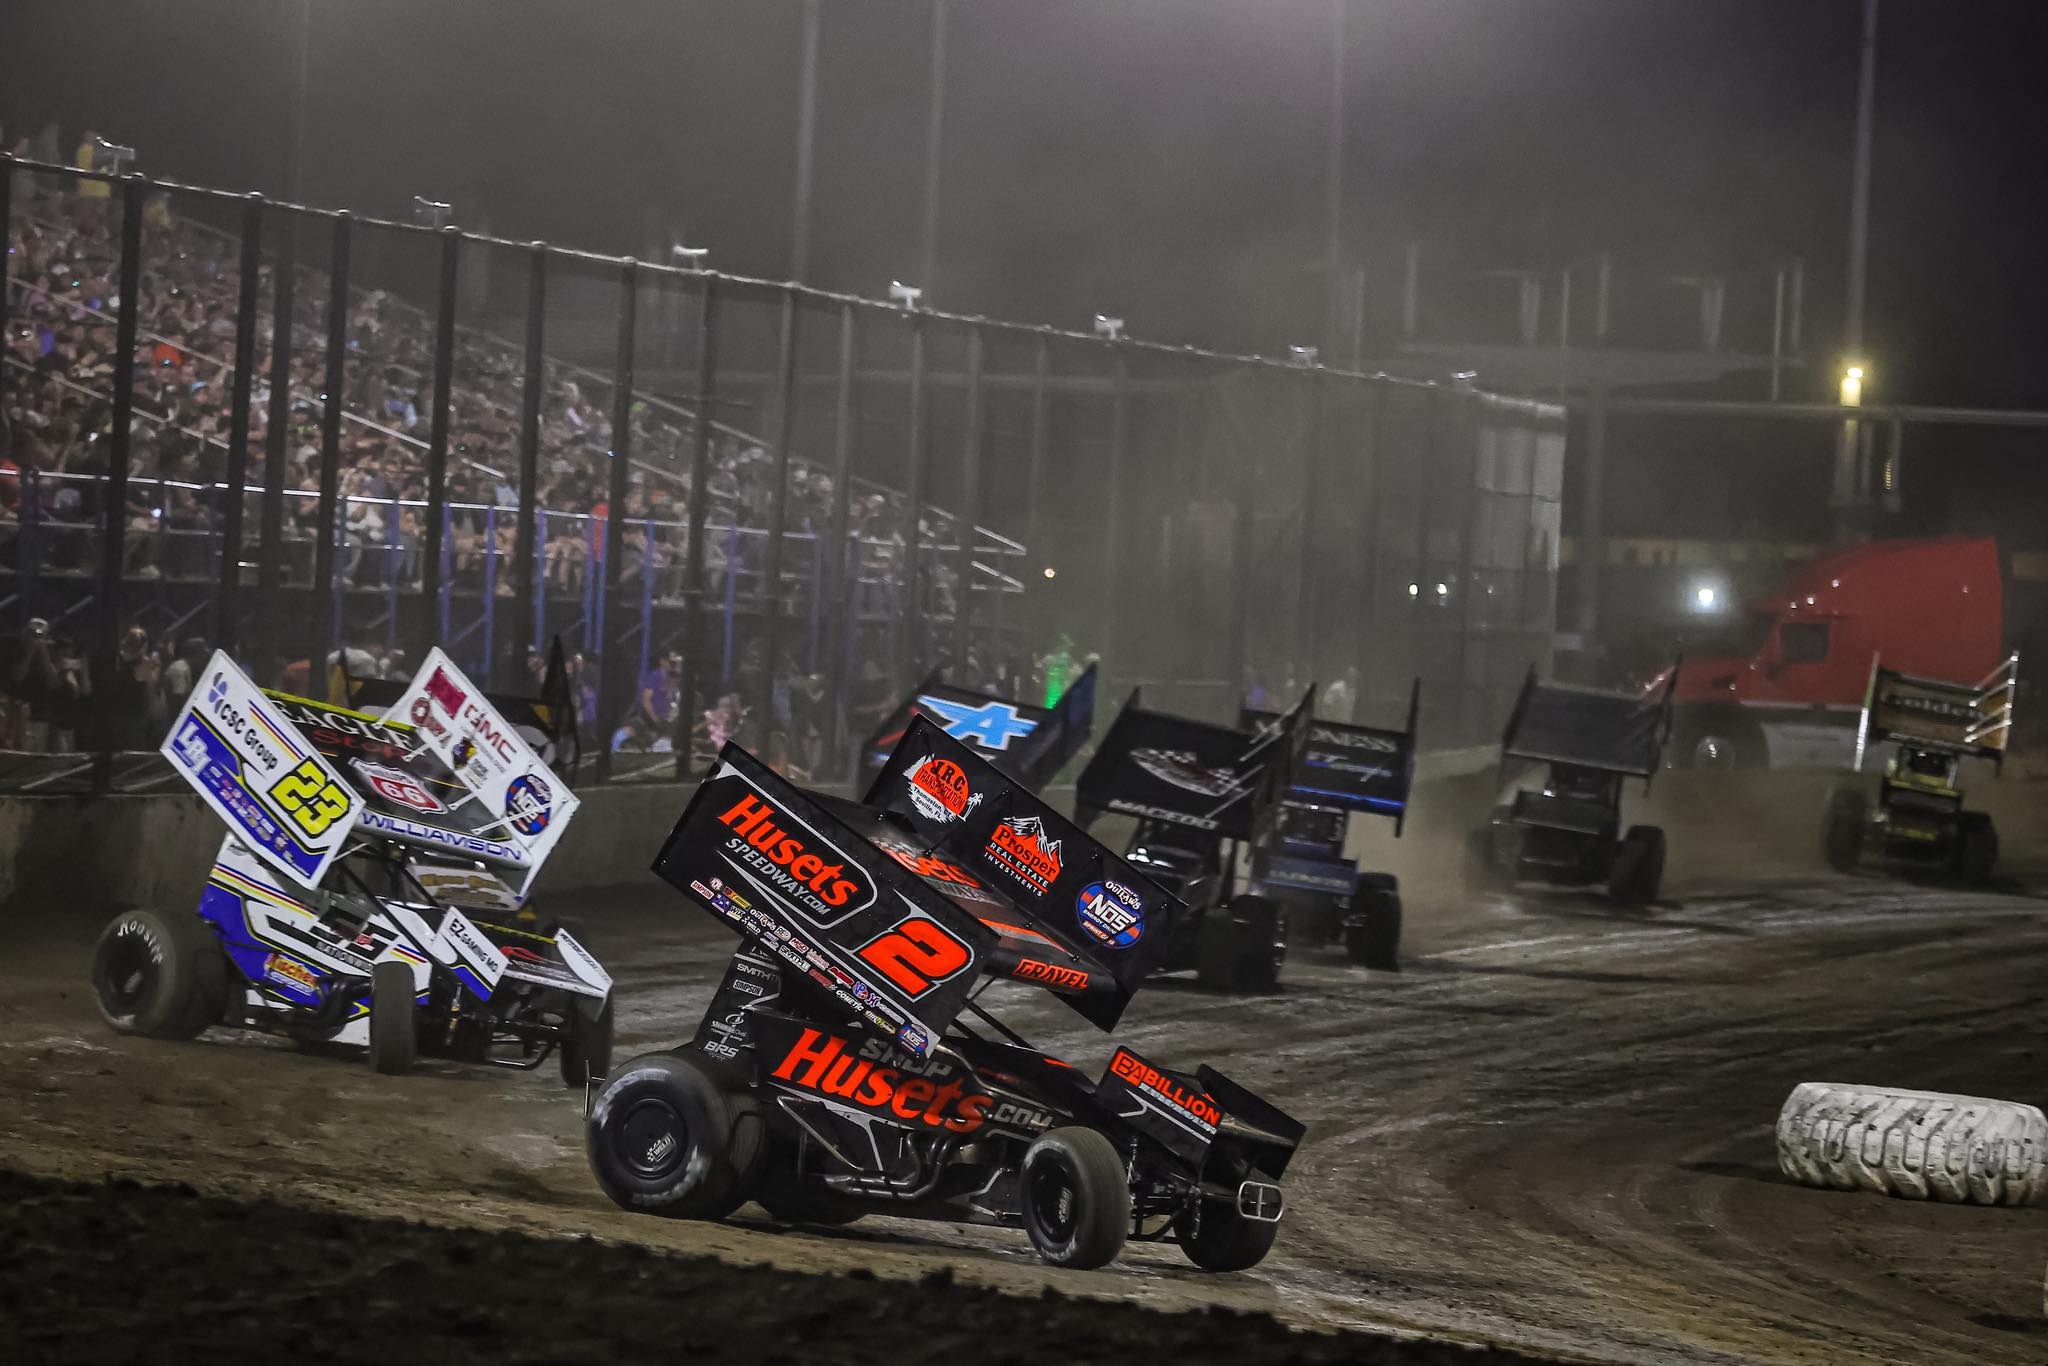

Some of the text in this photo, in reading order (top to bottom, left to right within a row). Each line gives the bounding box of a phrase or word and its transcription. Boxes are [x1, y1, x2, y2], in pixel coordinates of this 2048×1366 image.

[220, 704, 245, 734] CSC
[244, 729, 278, 770] Group
[267, 756, 353, 839] 23
[380, 781, 429, 804] 66
[913, 787, 943, 812] Thomaston,
[915, 796, 942, 819] Seville, FL
[918, 769, 963, 810] TRANSPORTATION
[360, 812, 522, 861] WILLIAMSON
[717, 793, 859, 907] Husets
[996, 828, 1056, 877] Prosper
[725, 838, 832, 916] SPEEDWAY.COM
[984, 852, 1043, 897] INVESTMENTS
[989, 842, 1013, 863] REAL
[1015, 860, 1049, 888] ESTATE
[1087, 893, 1137, 931] NOS
[1105, 881, 1141, 910] OUTLAWS
[450, 918, 465, 938] EZ
[1083, 909, 1102, 925] ENERGY
[859, 920, 968, 995] 2
[1013, 957, 1089, 989] GRAVEL
[704, 1040, 739, 1058] BRS
[903, 1029, 925, 1046] NOS
[771, 1027, 995, 1133] Husets
